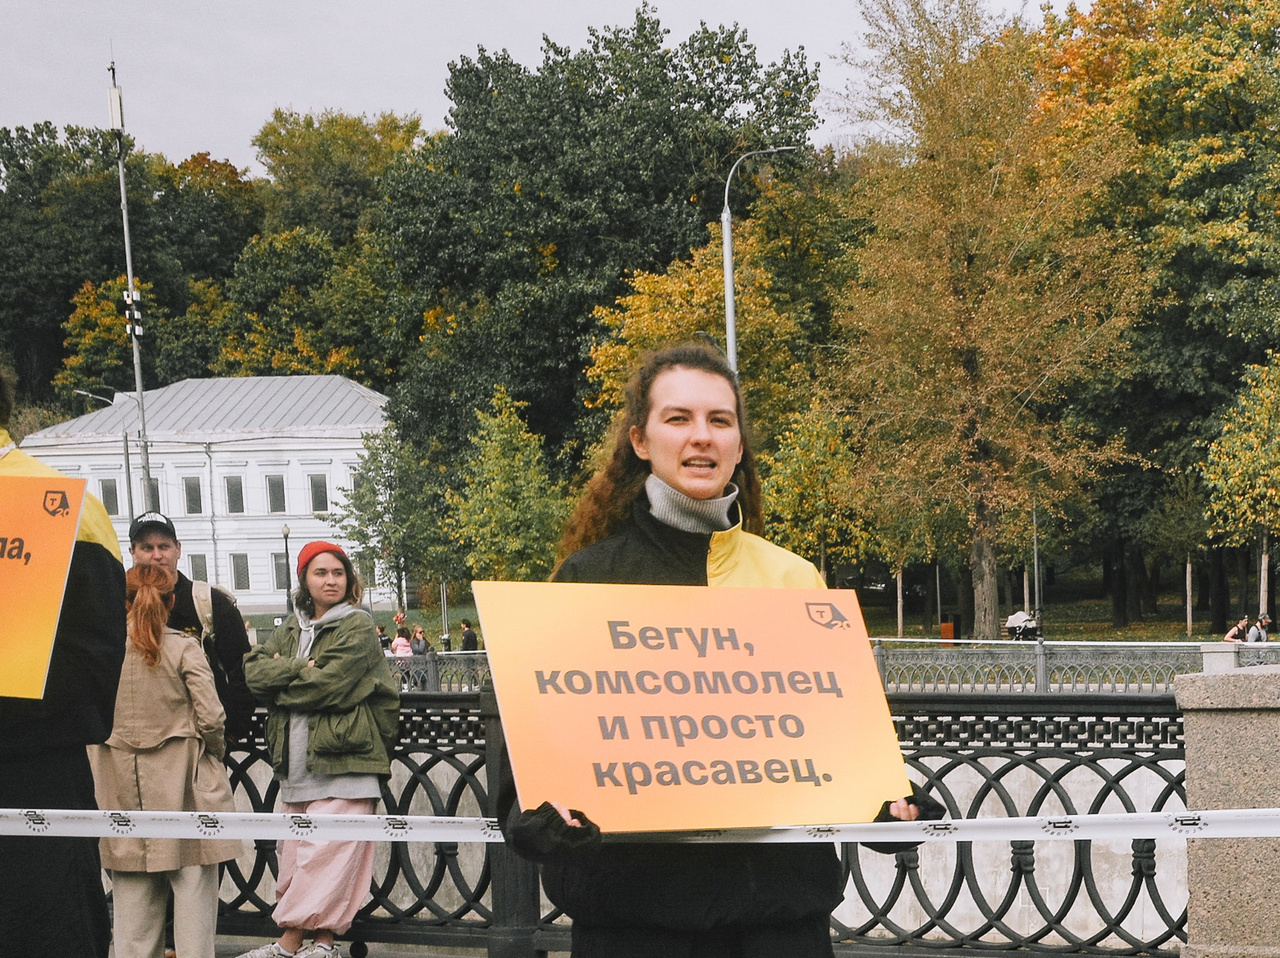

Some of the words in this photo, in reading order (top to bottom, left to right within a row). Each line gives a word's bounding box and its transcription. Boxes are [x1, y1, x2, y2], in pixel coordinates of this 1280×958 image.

[607, 620, 755, 658] Бегун,
[534, 669, 843, 698] комсомолец
[597, 714, 629, 741] и
[640, 713, 806, 747] просто
[592, 757, 833, 795] красавец.
